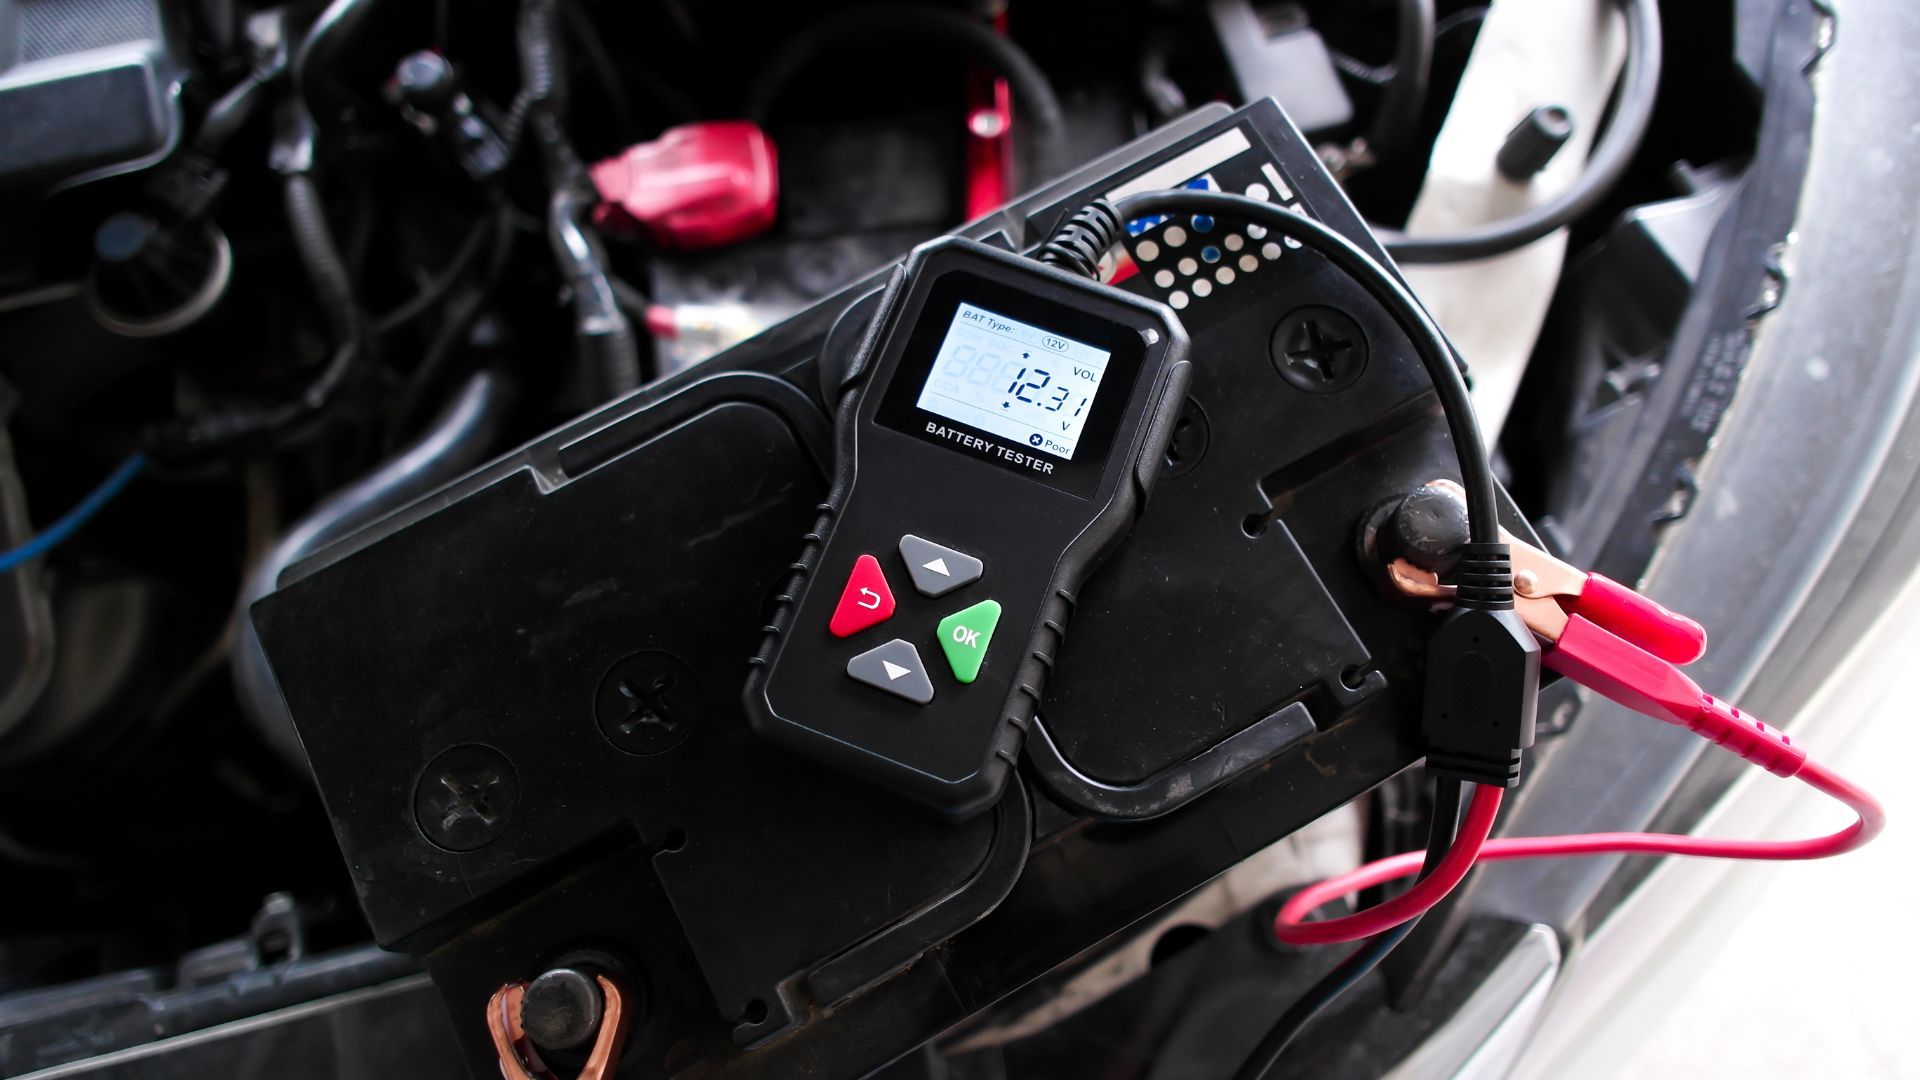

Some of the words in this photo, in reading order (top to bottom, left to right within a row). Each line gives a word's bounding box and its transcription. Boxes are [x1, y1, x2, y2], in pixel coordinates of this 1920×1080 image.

[962, 310, 985, 324] BAT
[987, 318, 1015, 334] Type:
[1046, 337, 1065, 350] 12V
[1073, 366, 1097, 382] VOL
[1062, 421, 1071, 431] V
[925, 421, 994, 453] BATTERY
[997, 446, 1054, 475] TESTER
[1045, 439, 1071, 455] Poor
[953, 625, 981, 649] OK
